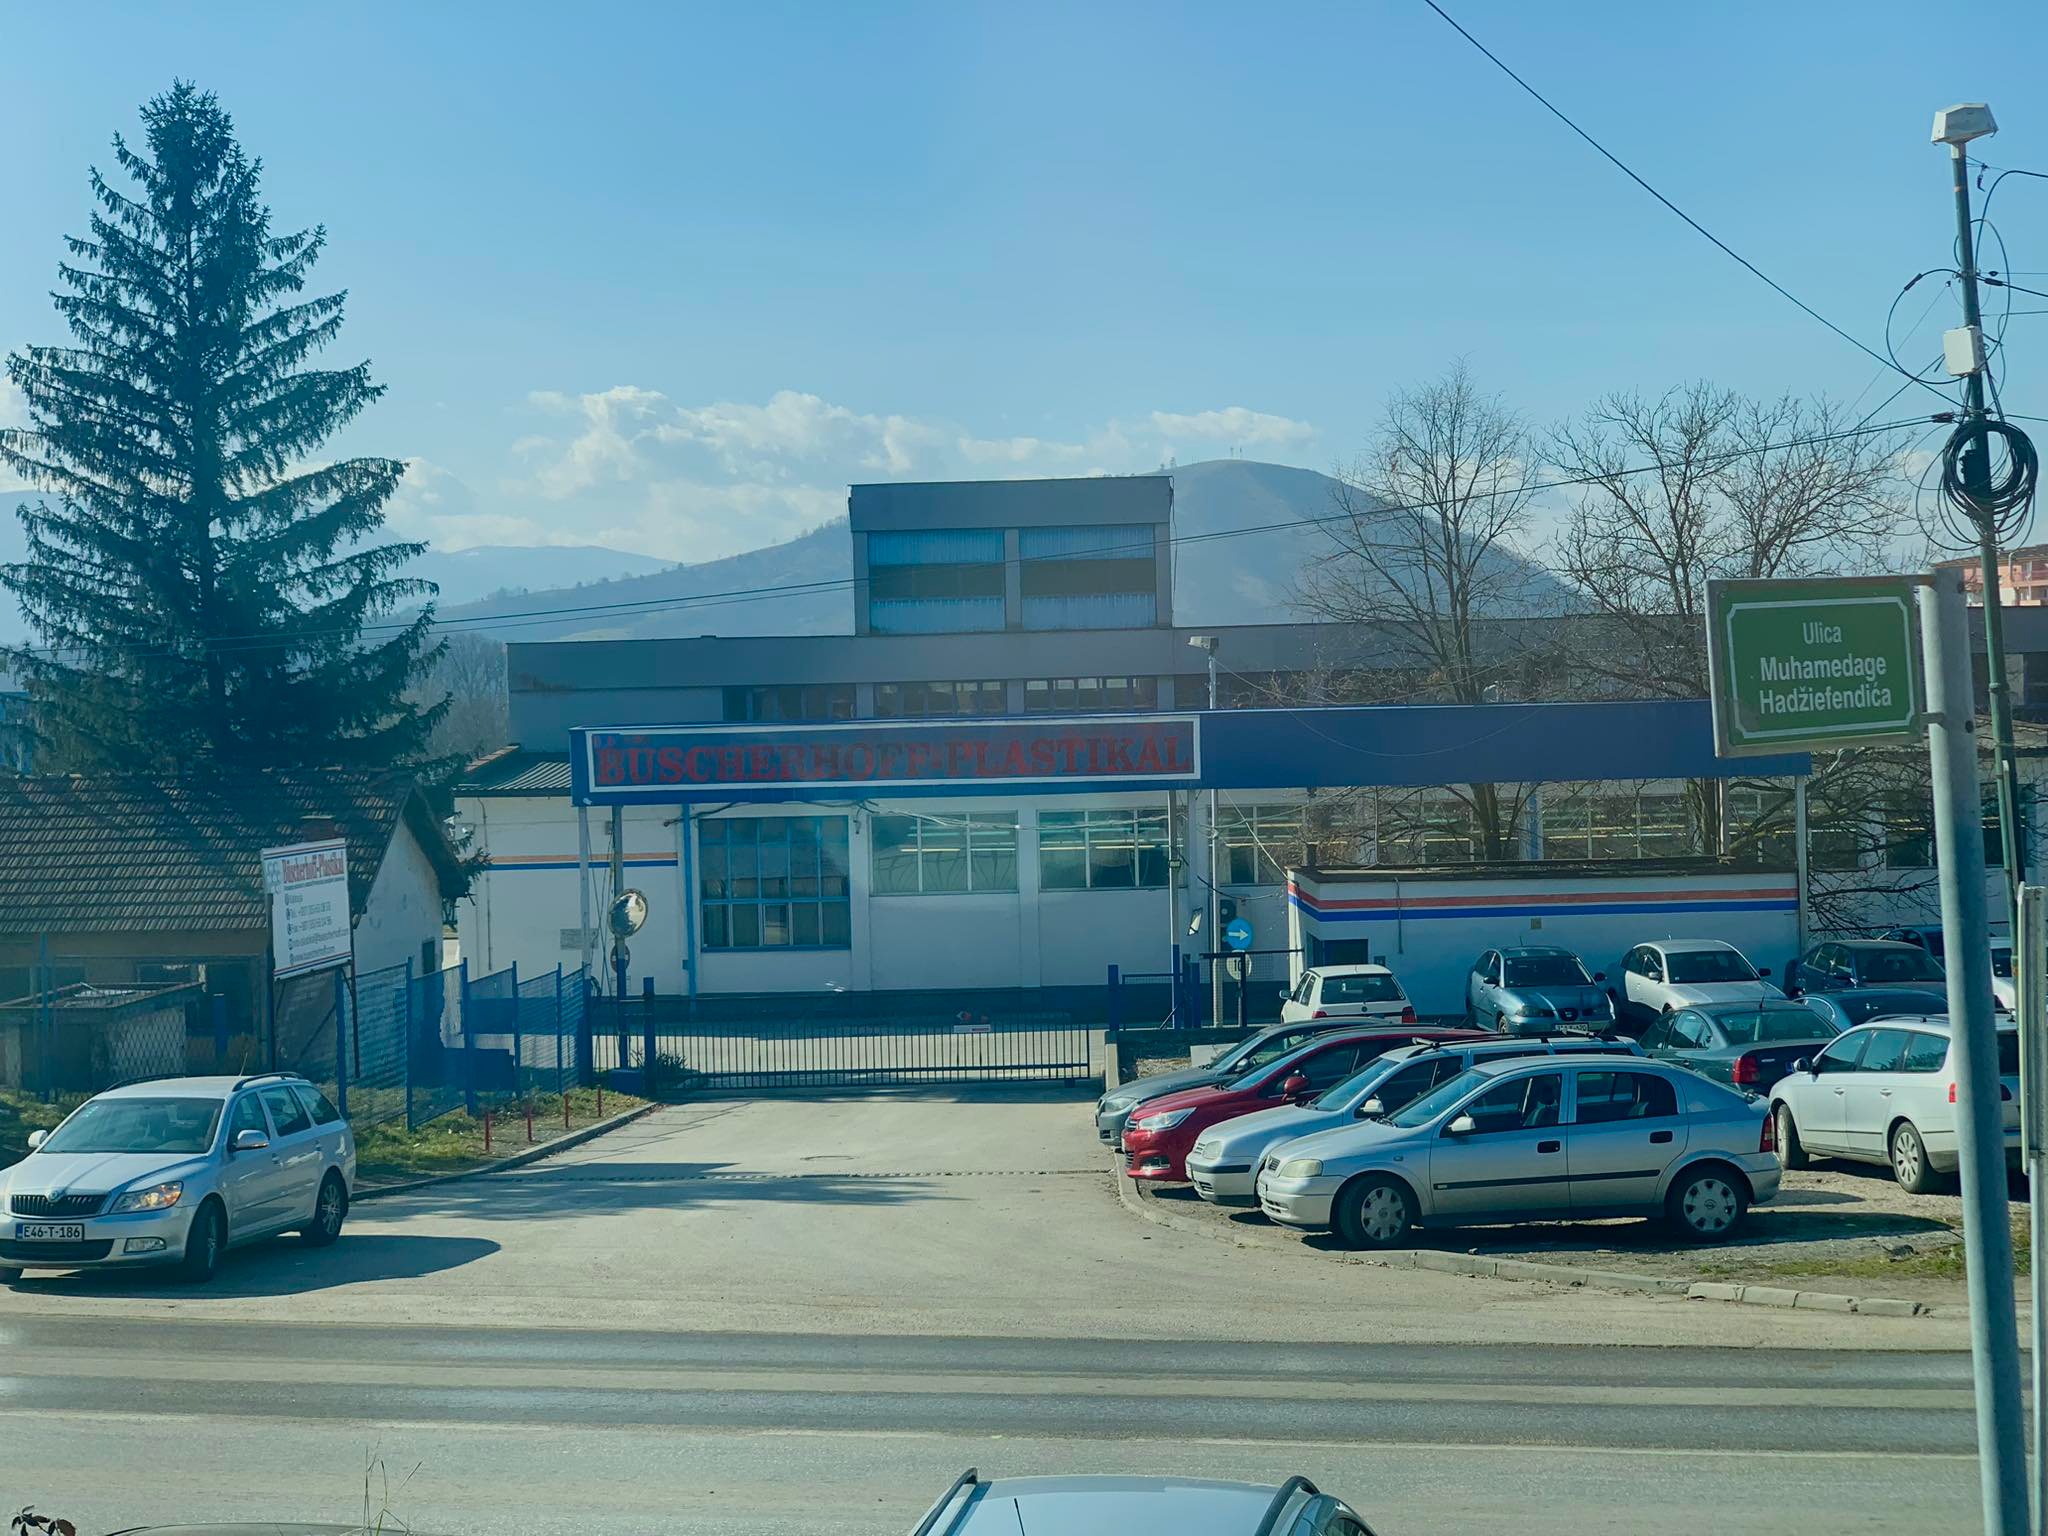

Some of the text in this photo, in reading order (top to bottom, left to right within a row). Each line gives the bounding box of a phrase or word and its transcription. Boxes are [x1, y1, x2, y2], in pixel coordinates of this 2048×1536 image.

[1802, 621, 1843, 645] Ulica
[1759, 653, 1887, 682] Muhamedage
[1759, 682, 1892, 715] Hadžiefendića
[24, 1226, 80, 1238] E46-T-186
